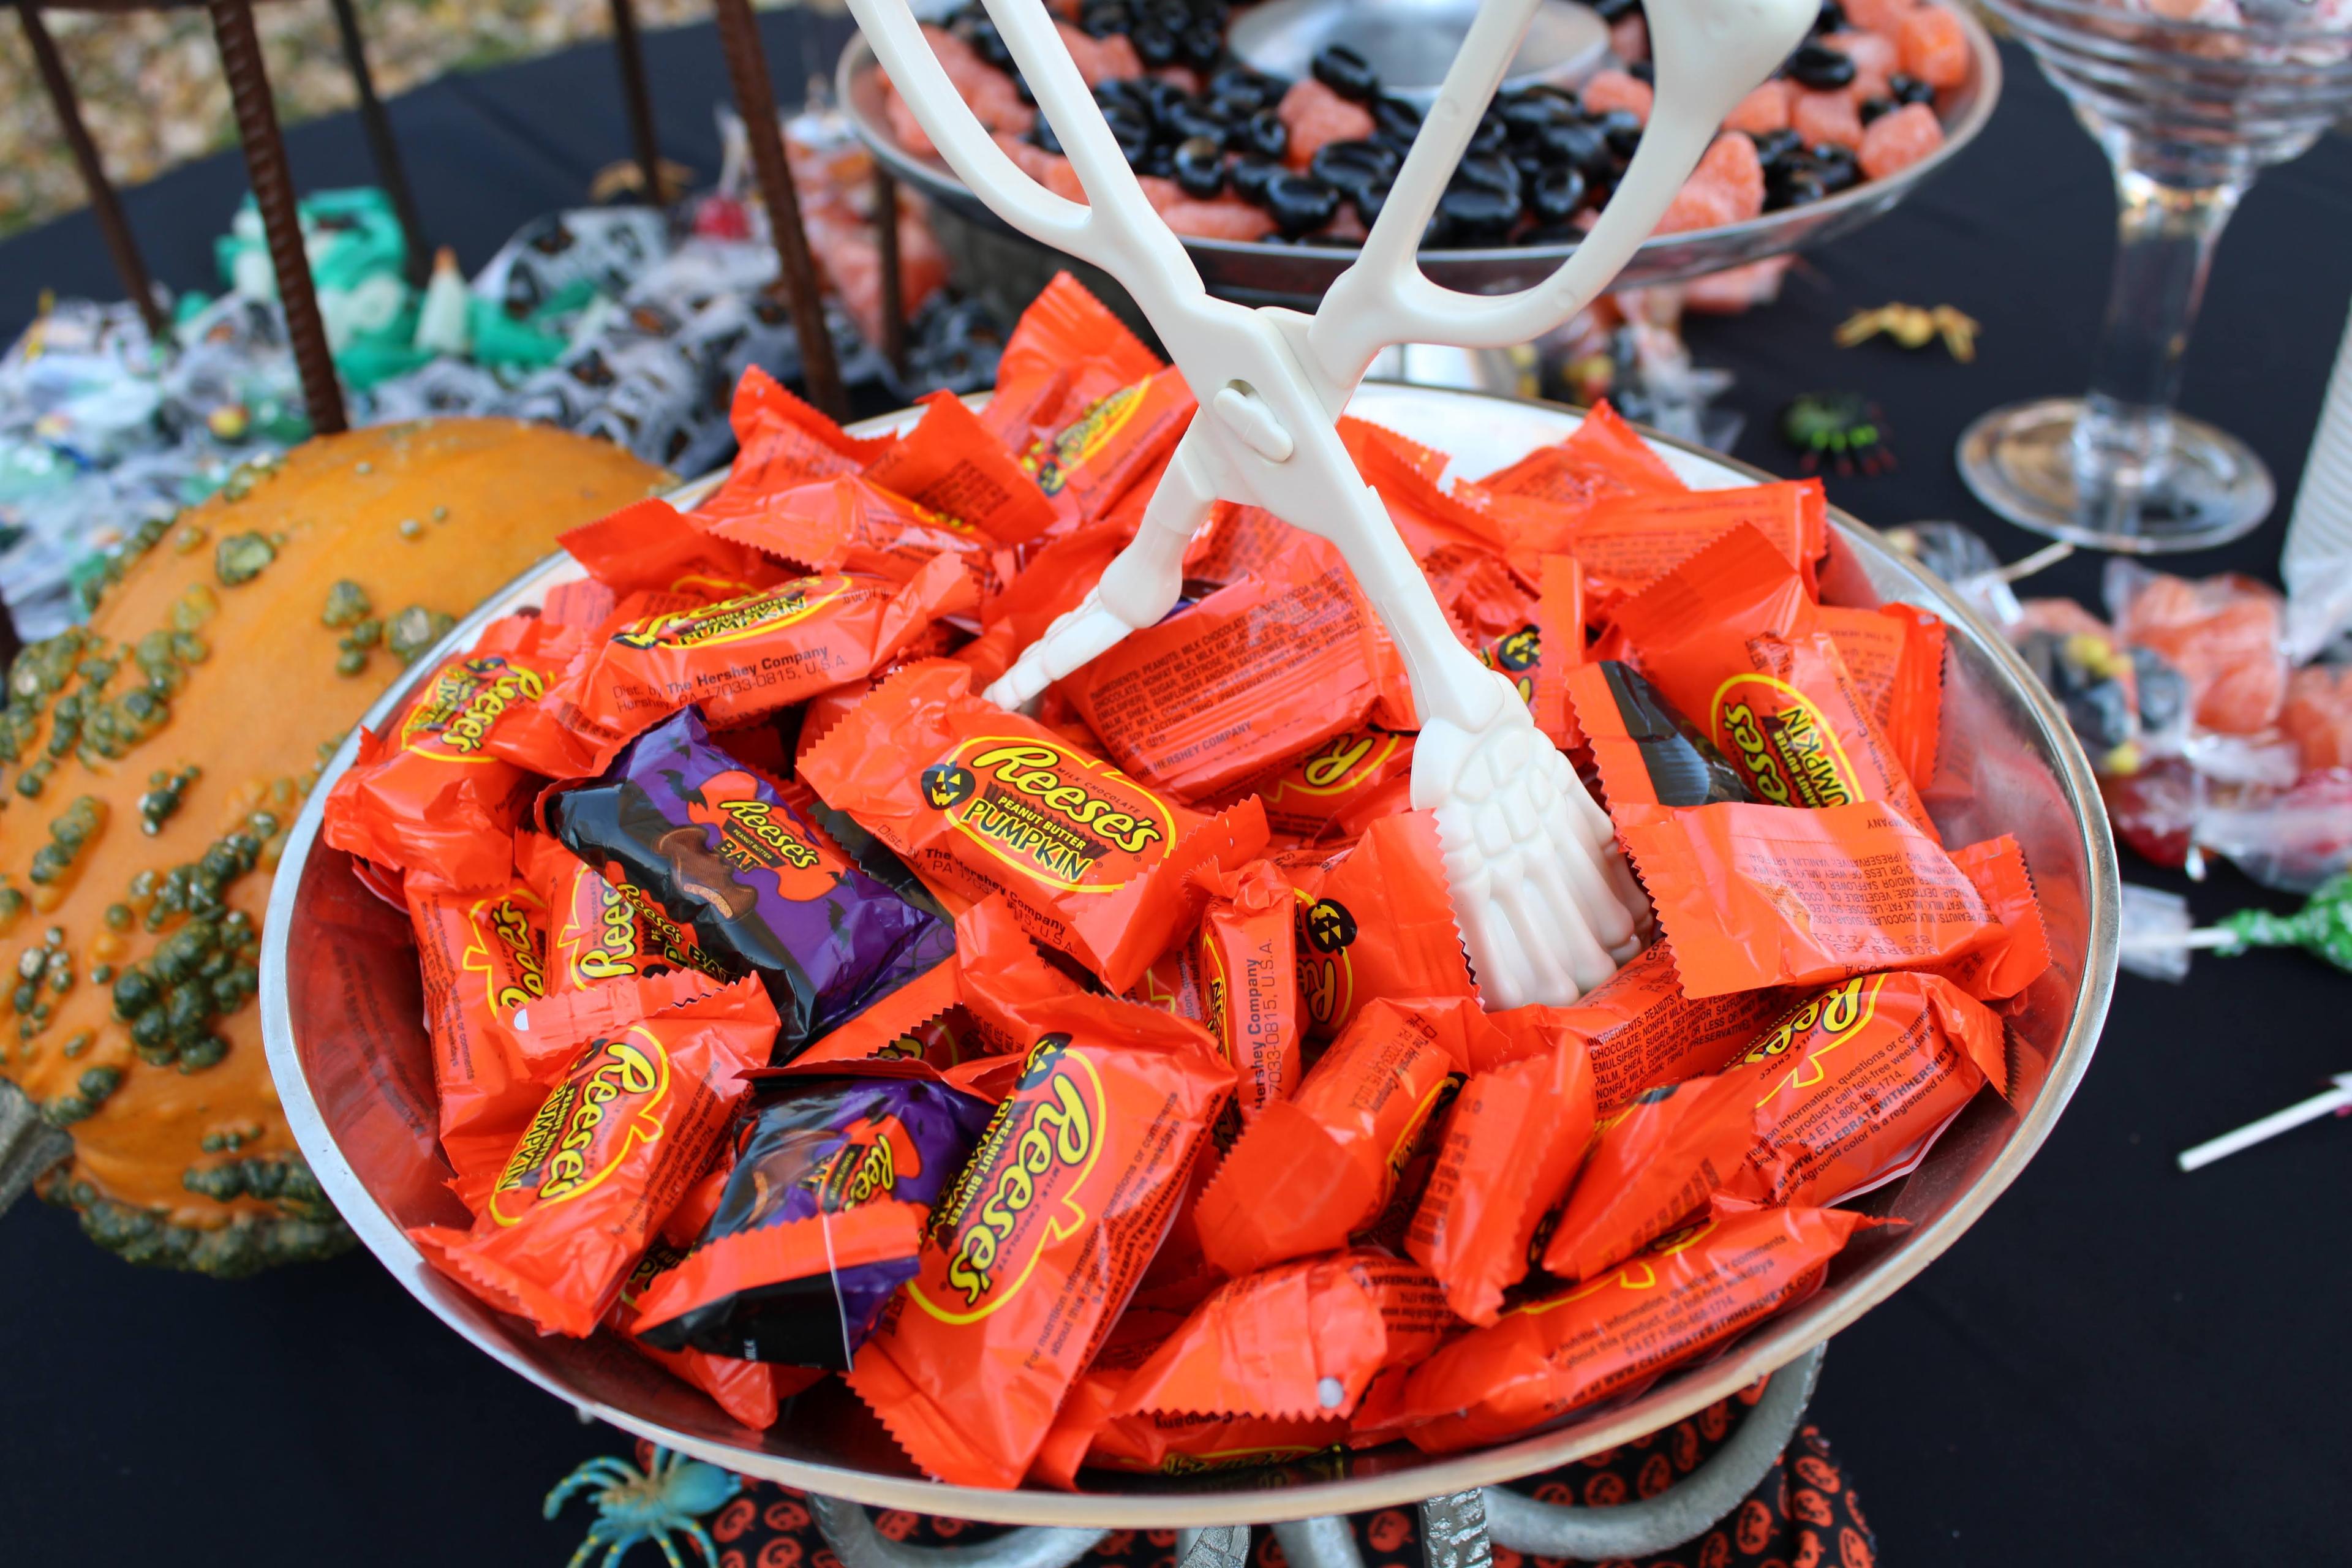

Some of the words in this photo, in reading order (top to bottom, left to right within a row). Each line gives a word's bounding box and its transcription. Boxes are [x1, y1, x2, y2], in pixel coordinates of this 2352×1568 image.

[676, 596, 808, 647] PUMPKIN
[666, 678, 692, 696] The
[696, 660, 758, 690] Hershey
[760, 641, 829, 675] Company
[804, 652, 848, 676] U.S.A.
[442, 665, 545, 755] Reese's
[1831, 675, 1874, 739] Company
[1152, 744, 1202, 773] HERSHEY
[1200, 720, 1253, 751] COMPANY
[1772, 729, 1802, 773] BUTTER
[970, 745, 1163, 853] Reese's
[1057, 766, 1081, 783] MILK
[1084, 780, 1141, 815] CHOCOLATE
[717, 799, 821, 870] Reese's
[731, 829, 754, 846] PEANUT
[750, 843, 773, 861] BUTTER
[960, 799, 1093, 883] PUMPKIN
[997, 795, 1043, 827] PEANUT
[1042, 815, 1087, 850] BUTTER
[714, 838, 764, 874] BAT
[1823, 869, 1847, 878] WHEY
[1864, 866, 1887, 876] LESS
[1888, 865, 1902, 875] OR
[922, 842, 952, 868] The
[1004, 890, 1069, 935] Company
[930, 858, 954, 878] PA
[1038, 925, 1080, 955] U.S.A.
[1826, 880, 1878, 890] SAFFLOWER
[1826, 891, 1841, 901] OIL
[1826, 903, 1843, 912] SOY
[1844, 890, 1891, 901] VEGETABLE
[1880, 878, 1914, 889] AND/OR
[616, 881, 684, 945] Reese's
[1866, 913, 1918, 925] CHOCOLATE
[1260, 938, 1276, 987] U.S.A.
[1244, 959, 1263, 1035] Company
[1587, 1016, 1645, 1047] INGREDIENTS:
[1644, 995, 1676, 1021] PEANUTS;
[459, 1033, 475, 1080] comments
[1589, 1030, 1642, 1061] CHOCOLATE;
[1642, 1014, 1670, 1036] NONFAT
[1668, 1003, 1687, 1020] MILK;
[1591, 1044, 1644, 1074] EMULSIFIER);
[1644, 1027, 1673, 1049] SUGAR;
[1594, 1080, 1626, 1100] NONFAT
[1627, 1066, 1646, 1085] MILK;
[1646, 1042, 1680, 1069] CONTAINS
[1691, 1027, 1701, 1041] OR
[1703, 1015, 1726, 1032] LESS
[1621, 1056, 1644, 1075] SHEA,
[1644, 1028, 1685, 1058] SUNFLOWER
[1686, 1010, 1712, 1031] AND/OR
[1792, 1028, 1820, 1052] MILK
[549, 1085, 581, 1131] PEANUT
[1772, 1131, 1794, 1150] this
[1792, 1101, 1836, 1137] product,
[1833, 1088, 1855, 1106] call
[1852, 1061, 1891, 1092] toll-free
[1890, 1023, 1936, 1066] weekdays
[1777, 1082, 1839, 1129] information,
[1836, 1048, 1887, 1088] questions
[1884, 1040, 1898, 1053] or
[1798, 1132, 1816, 1149] 9-4
[1815, 1121, 1831, 1136] ET
[1830, 1067, 1905, 1125] 1-800-468-1714.
[495, 1078, 572, 1191] PUMPKIN
[538, 1044, 657, 1199] Reese's
[977, 1117, 1016, 1174] PEANUT
[1786, 1147, 1843, 1196] background
[1841, 1128, 1871, 1153] color
[1868, 1121, 1881, 1134] is
[1887, 1077, 1939, 1120] registered
[527, 1129, 557, 1174] BUTTER
[946, 1173, 984, 1227] BUTTER
[949, 1073, 1091, 1307] Reese's
[1038, 1166, 1062, 1199] MILK
[995, 1204, 1039, 1273] CHOCOLATE
[1022, 1346, 1042, 1370] For
[1035, 1294, 1071, 1349] nutrition
[1061, 1221, 1106, 1294] information,
[1100, 1162, 1139, 1222] questions
[1132, 1147, 1148, 1164] or
[1140, 1090, 1180, 1150] comments
[1047, 1319, 1074, 1357] about
[1068, 1295, 1087, 1321] this
[1143, 1118, 1183, 1177] weekdays
[1730, 1234, 1787, 1272] comments
